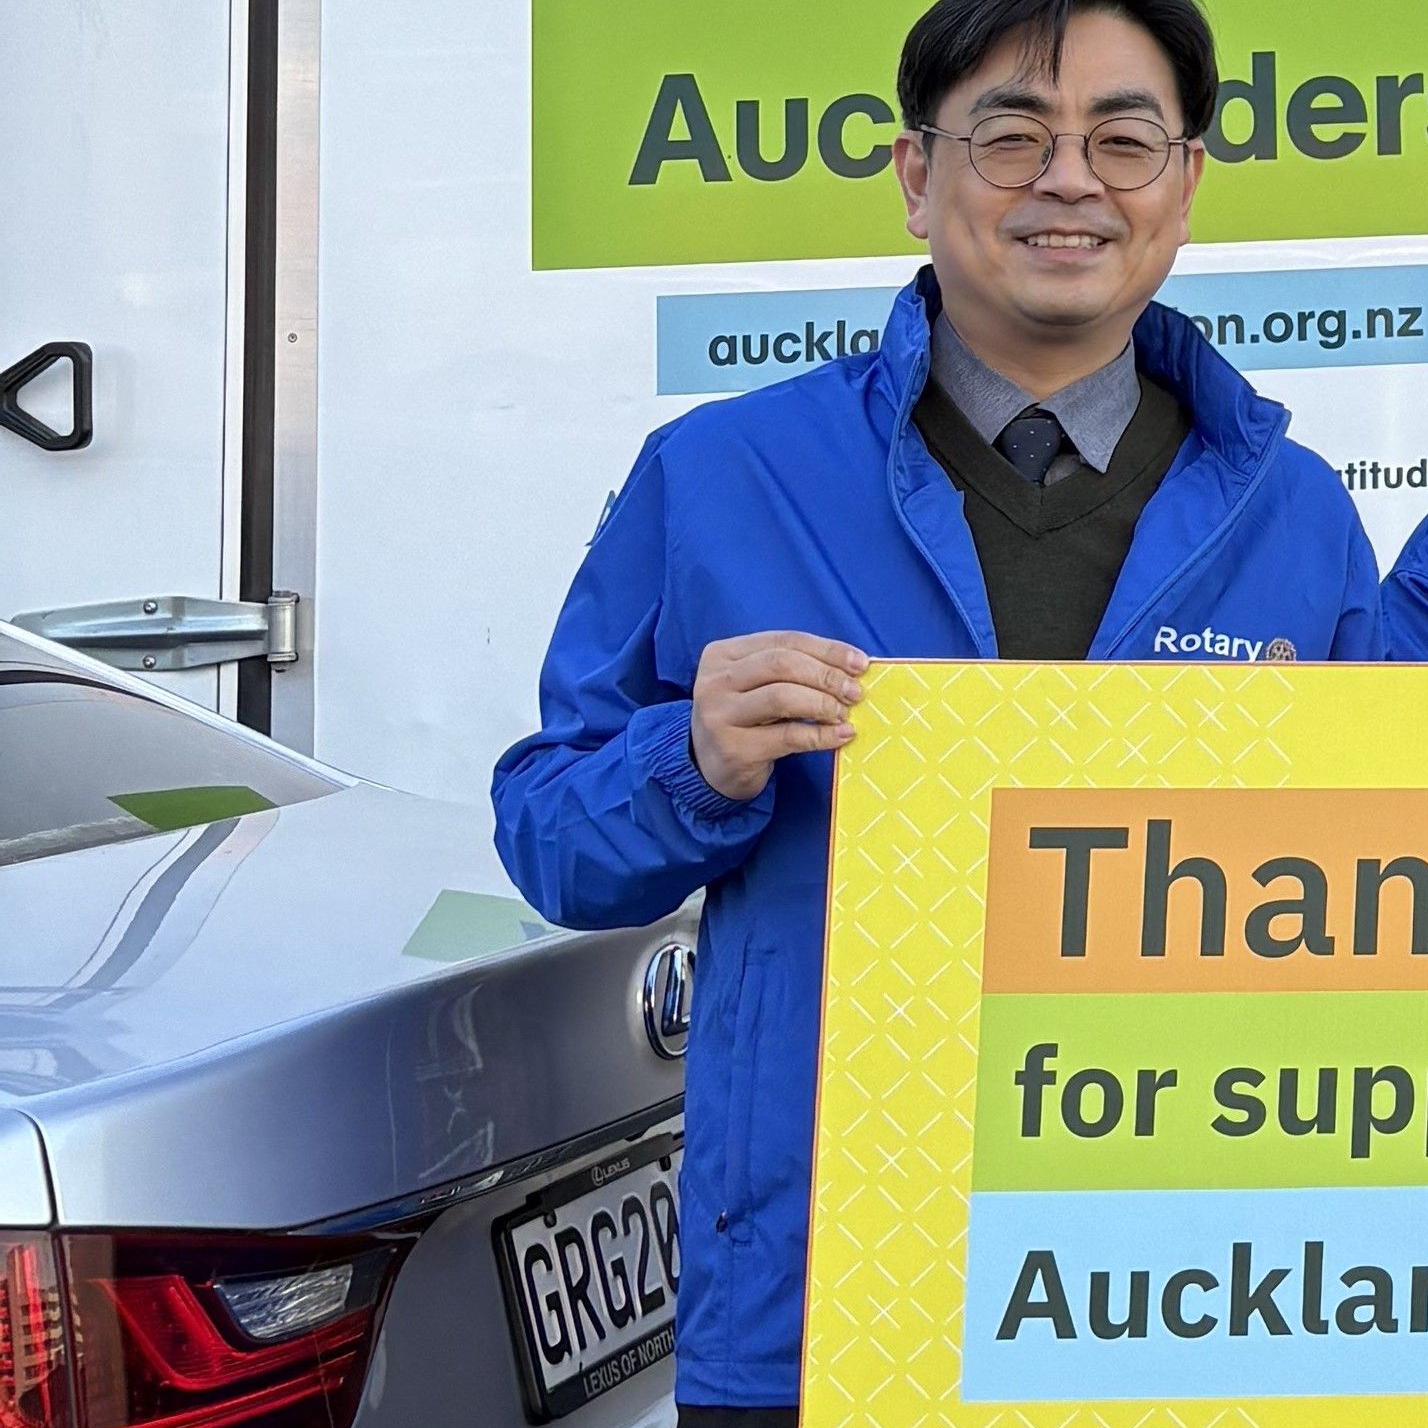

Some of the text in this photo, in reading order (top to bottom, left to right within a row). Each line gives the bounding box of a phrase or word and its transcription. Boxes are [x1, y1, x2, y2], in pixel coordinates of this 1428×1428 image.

[1153, 625, 1264, 662] Rotary
[1014, 1043, 1178, 1138] for
[524, 1180, 681, 1365] GRG20
[583, 1360, 622, 1398] LEXUS
[620, 1349, 640, 1375] OF
